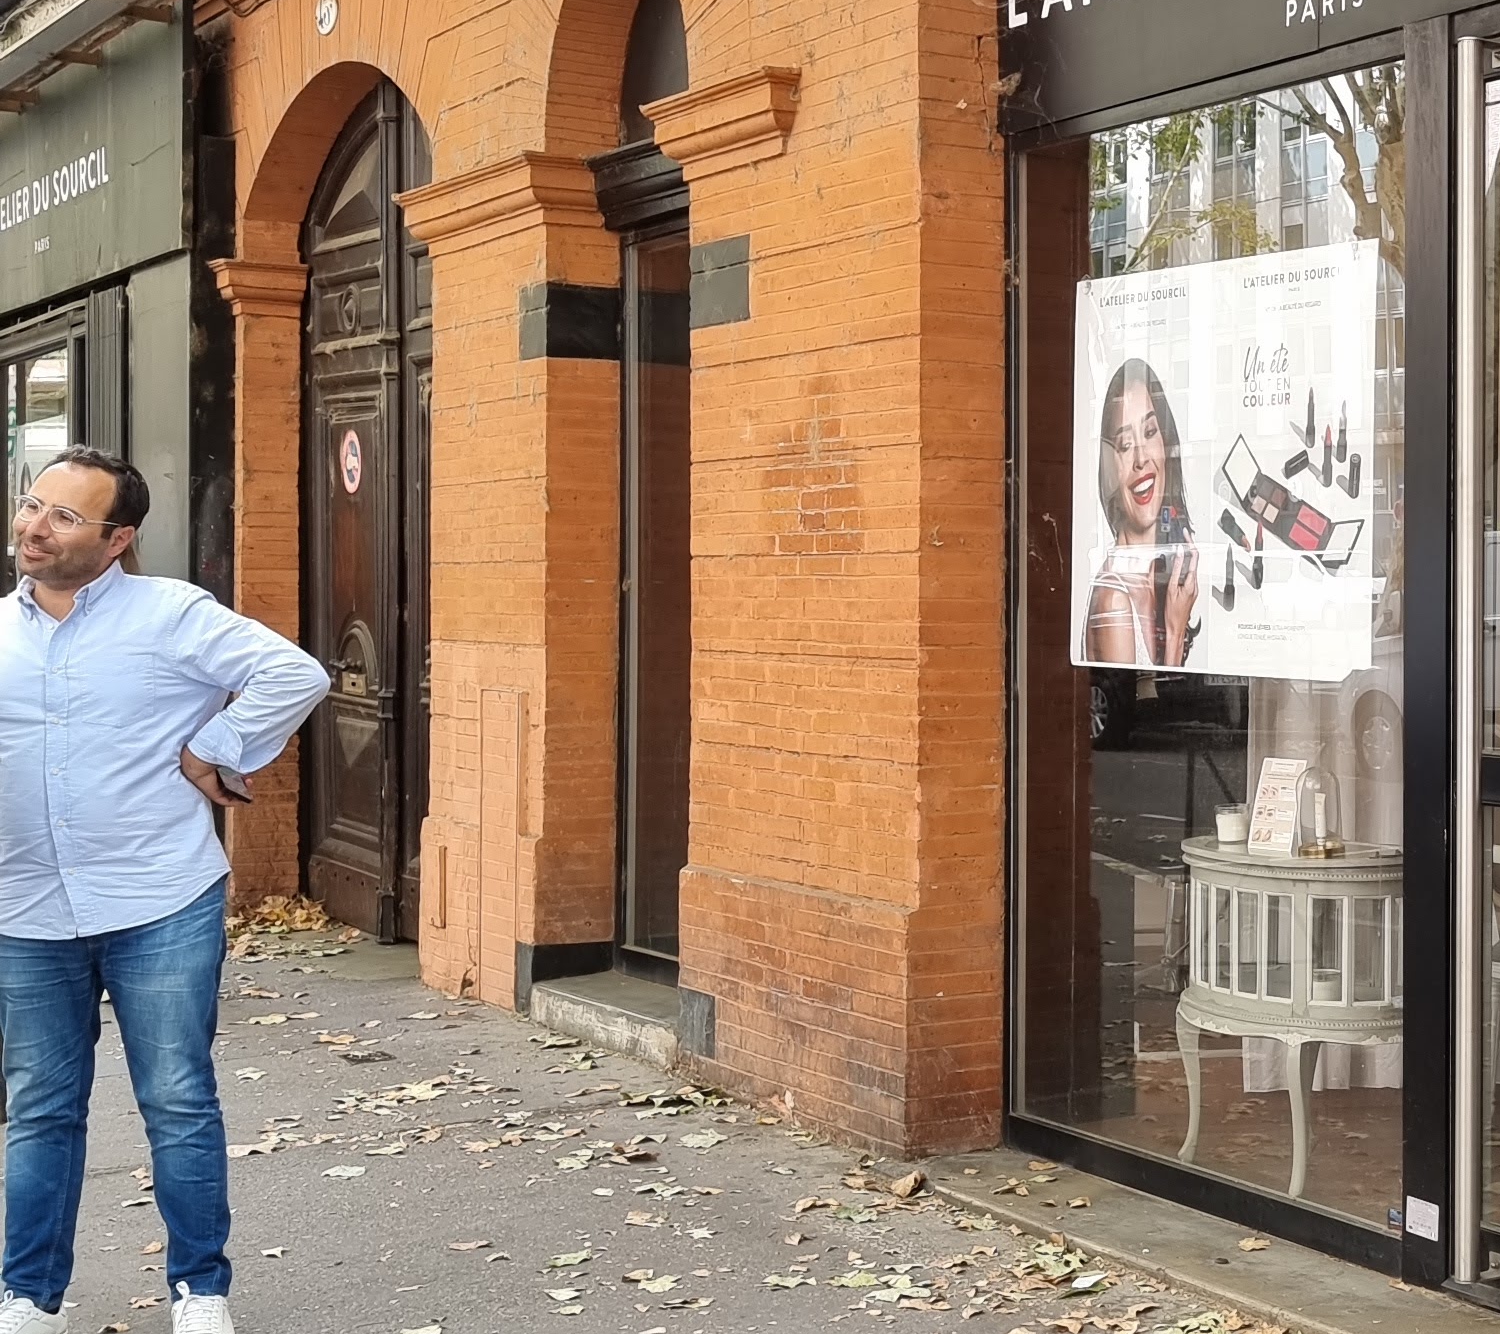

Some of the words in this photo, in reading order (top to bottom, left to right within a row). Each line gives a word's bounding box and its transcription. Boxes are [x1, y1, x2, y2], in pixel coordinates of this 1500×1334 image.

[32, 175, 50, 216] DU
[53, 146, 109, 206] SOURCIL
[34, 236, 50, 254] PARIS
[1243, 273, 1285, 289] L'ATELIER
[1288, 270, 1301, 283] DU
[1304, 266, 1340, 281] SOURCI
[1099, 293, 1135, 308] L'ATELIER
[1137, 291, 1149, 303] DU
[1151, 286, 1187, 301] SOURCIL
[1243, 345, 1265, 380] Un
[1269, 342, 1290, 374] été
[1276, 376, 1291, 391] EN
[1242, 392, 1291, 408] COUEUR
